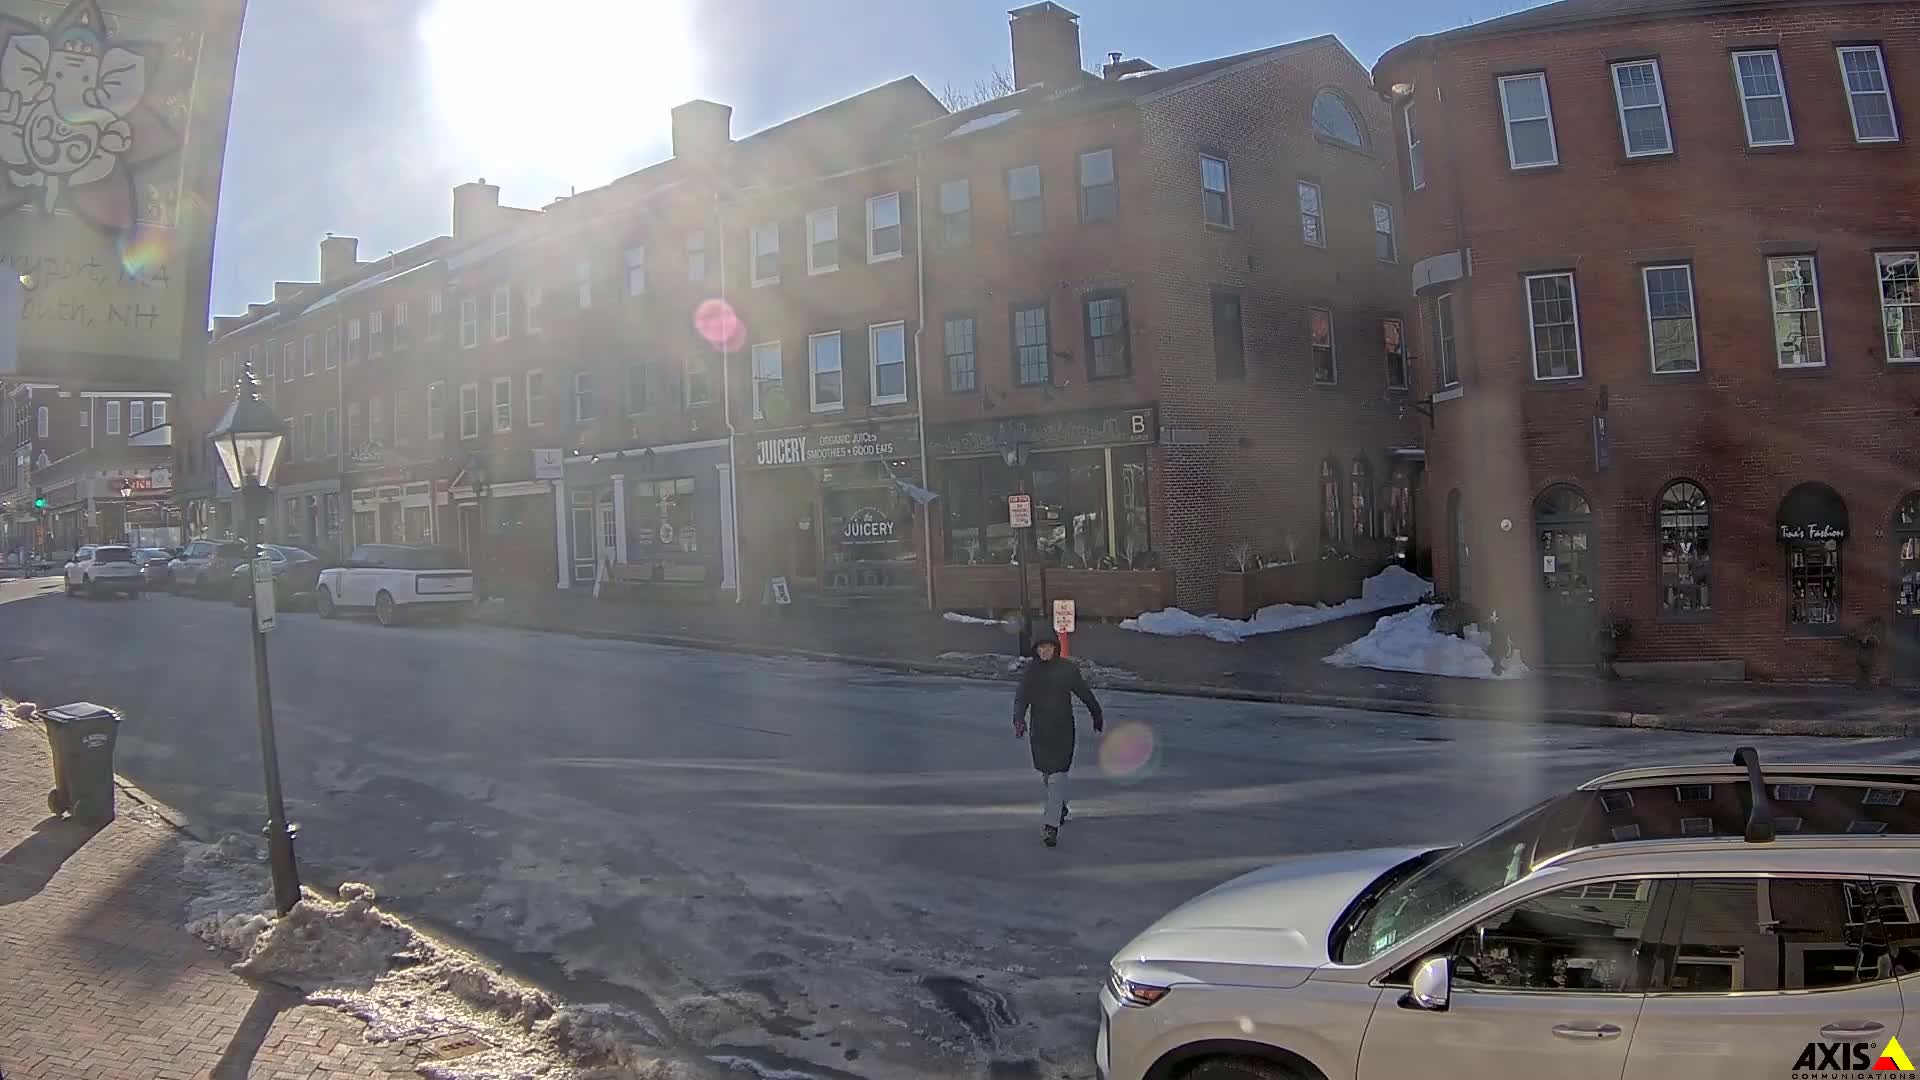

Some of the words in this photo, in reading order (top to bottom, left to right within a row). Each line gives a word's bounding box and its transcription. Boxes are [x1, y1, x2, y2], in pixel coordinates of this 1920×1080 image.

[107, 303, 160, 328] NH
[1131, 415, 1145, 433] B
[852, 432, 877, 443] JUICES
[757, 436, 806, 464] JUICERY
[806, 447, 846, 459] SMOOTHIES
[852, 445, 874, 456] GOOD
[876, 443, 893, 454] EATS
[844, 522, 894, 536] JUICERY
